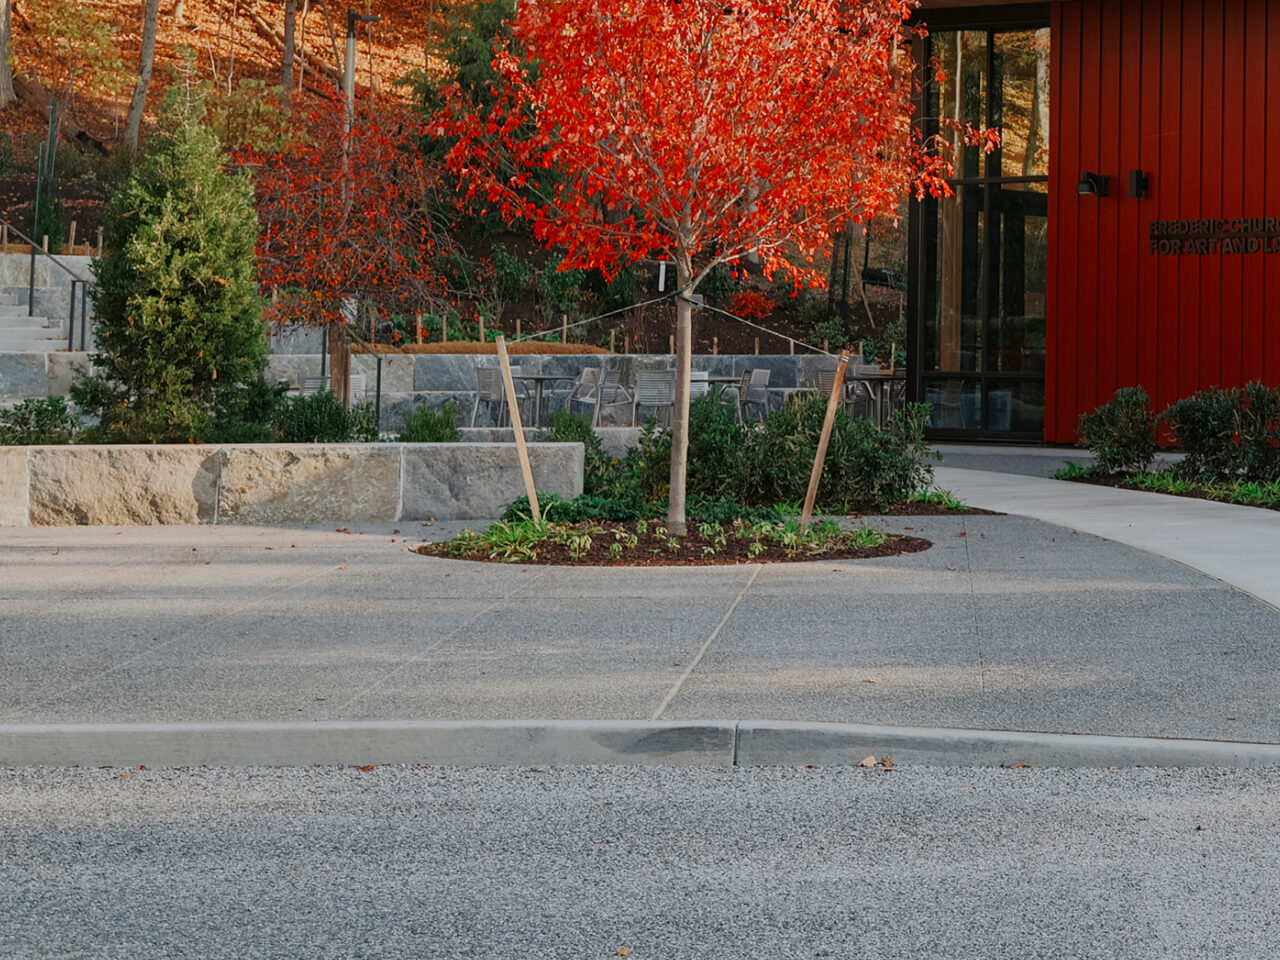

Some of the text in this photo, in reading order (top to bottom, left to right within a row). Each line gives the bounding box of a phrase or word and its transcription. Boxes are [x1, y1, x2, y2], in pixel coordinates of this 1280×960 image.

[1150, 219, 1228, 235] FREDERIC
[1150, 239, 1182, 255] FOR
[1187, 238, 1218, 254] ART
[1222, 237, 1260, 253] AND
